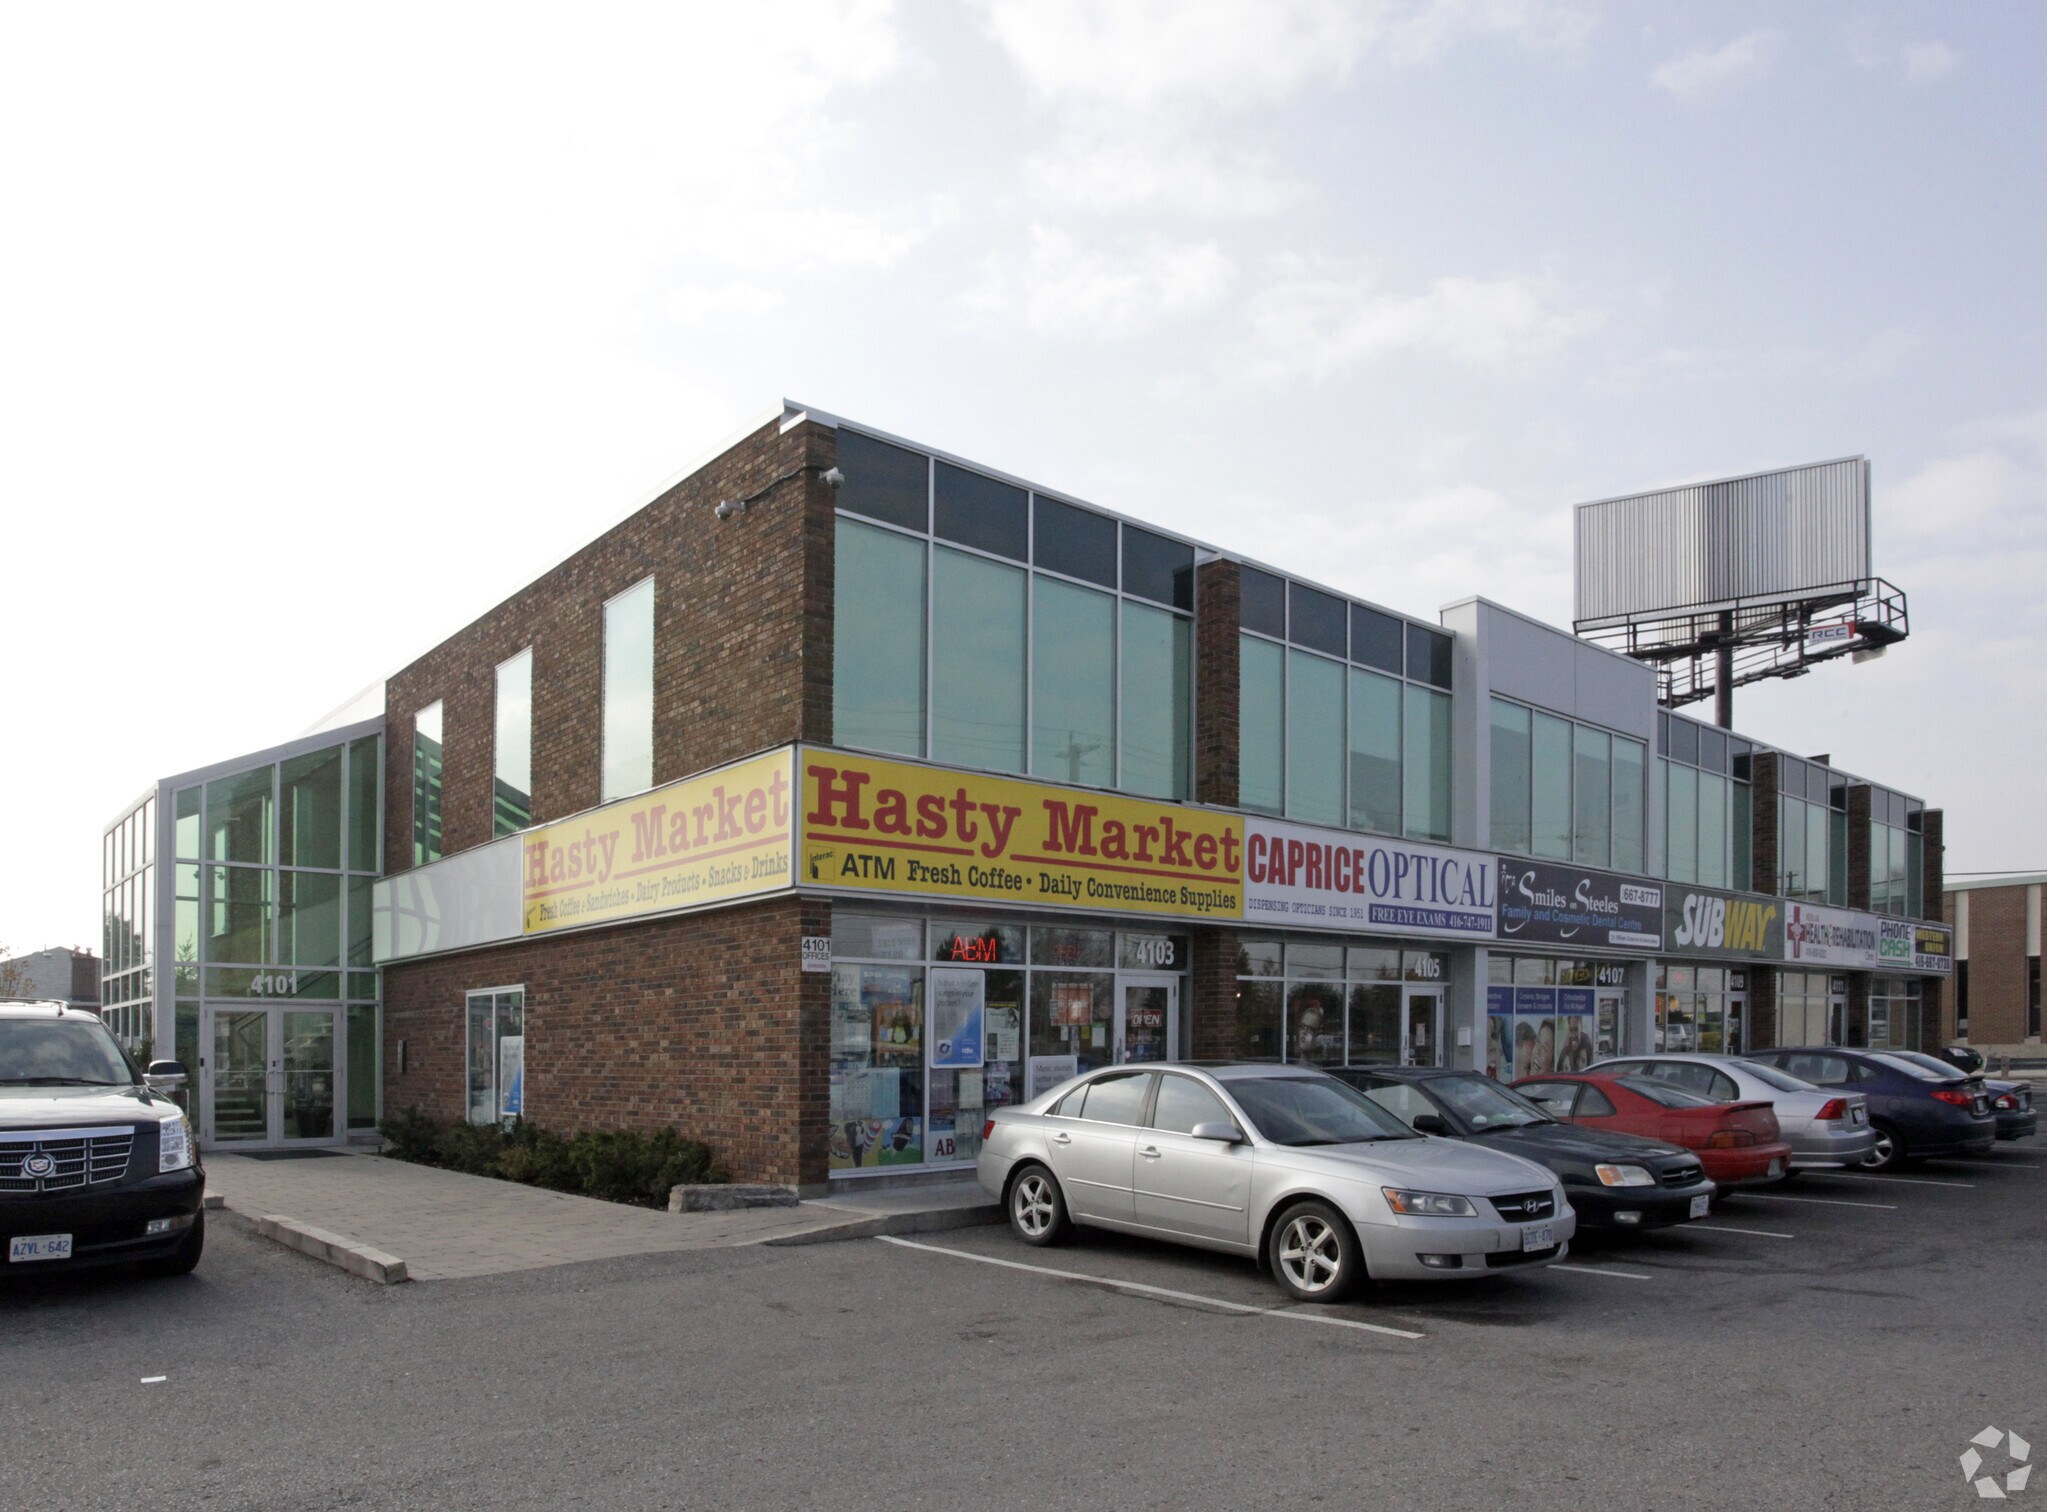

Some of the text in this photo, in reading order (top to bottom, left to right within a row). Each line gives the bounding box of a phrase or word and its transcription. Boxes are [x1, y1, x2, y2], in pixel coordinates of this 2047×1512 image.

[525, 769, 789, 889] Hasty Market
[807, 765, 1240, 873] Hasty Market
[810, 851, 834, 867] Interac
[1248, 833, 1495, 908] CAPRICE OPTICAL
[540, 902, 558, 921] Fresh
[560, 897, 580, 917] Coffee
[587, 888, 629, 912] Sandwiches
[636, 880, 660, 903] Dairy
[662, 871, 700, 897] Products
[708, 862, 742, 888] Snacks
[752, 851, 788, 879] Drinks
[841, 853, 1236, 912] ATM Fresh Coffee Daily Convenience Supplies
[1518, 871, 1566, 908] Smiles
[1575, 879, 1618, 913] Steeles
[1624, 888, 1659, 905] 667-8777
[1248, 898, 1289, 912] DISPENSING
[1292, 902, 1326, 916] OPTICIANS
[1329, 906, 1347, 918] SINCE
[1502, 903, 1642, 931] Family and Cosmetic Dental Centre
[1372, 907, 1491, 930] FREE EYE EXAMS 416-747-1911
[1674, 893, 1776, 951] SUBWAY
[1806, 922, 1828, 945] HEALTH
[1833, 926, 1875, 950] REHABILITATION
[1881, 922, 1910, 940] PHONE
[803, 938, 830, 952] 4101
[1136, 940, 1175, 965] 4103
[1880, 938, 1910, 958] CASH
[802, 951, 830, 961] OFFICES
[1415, 958, 1441, 978] 4105
[1599, 967, 1625, 984] 4107
[251, 974, 297, 994] 4101
[1132, 1014, 1160, 1025] OPEN
[13, 1240, 69, 1256] AZVL 642
